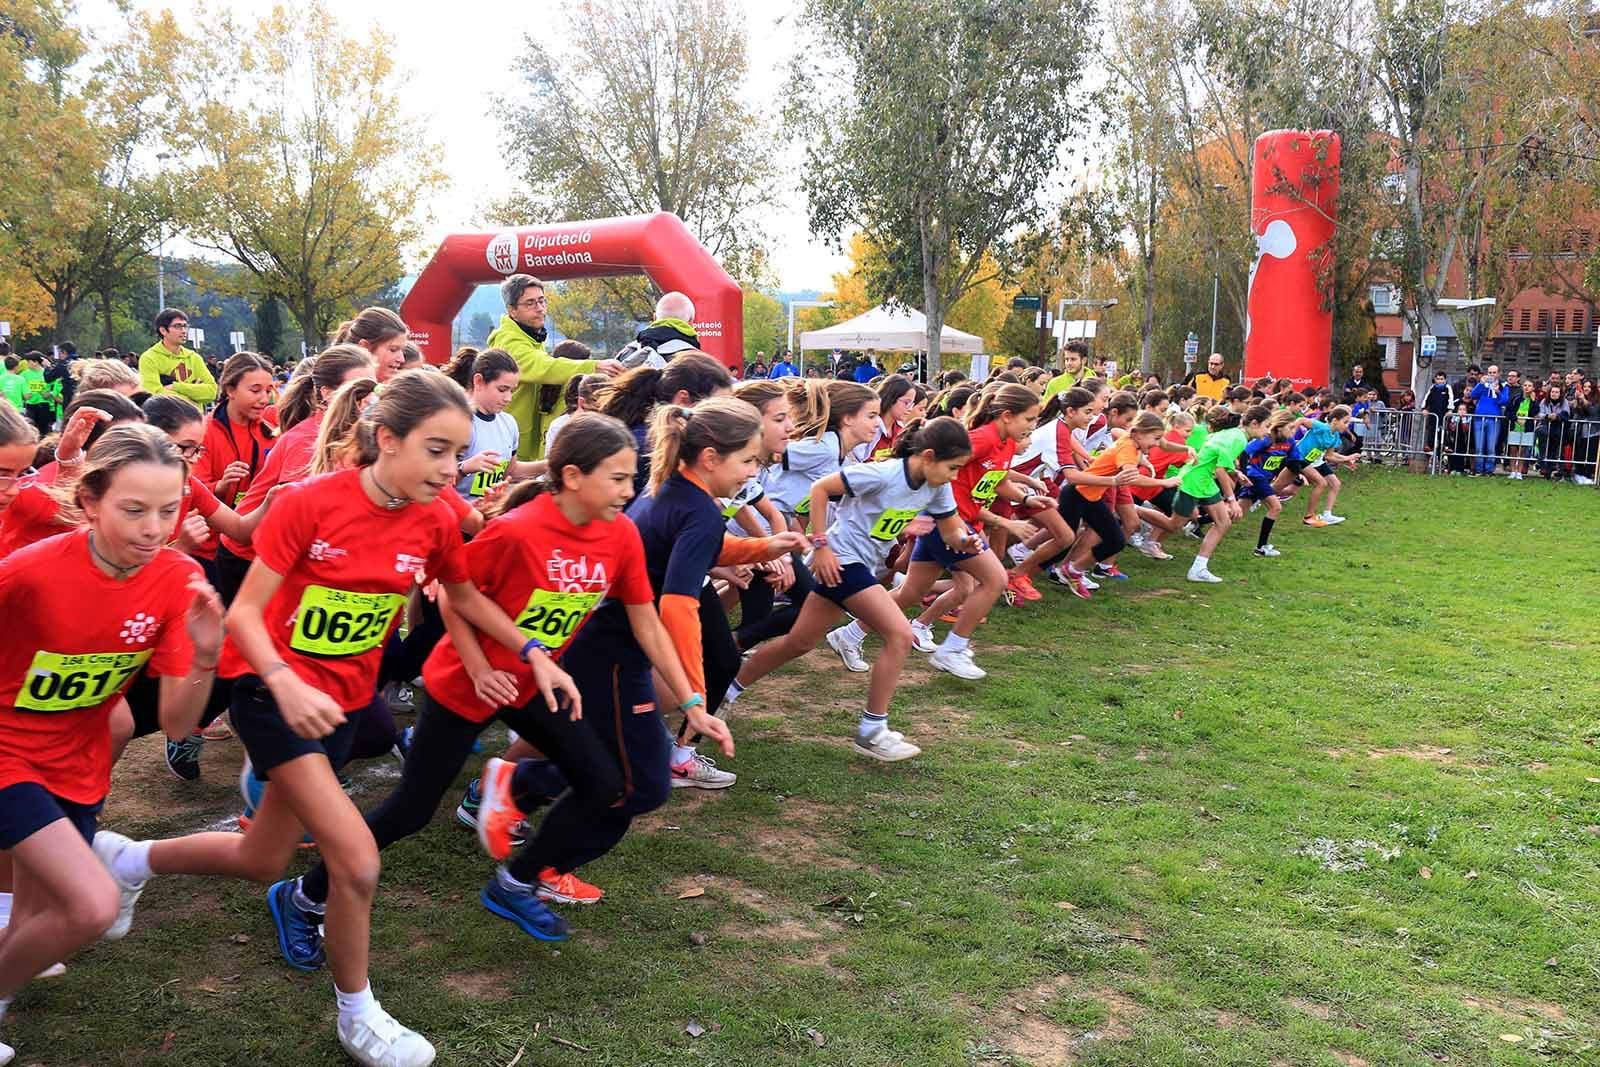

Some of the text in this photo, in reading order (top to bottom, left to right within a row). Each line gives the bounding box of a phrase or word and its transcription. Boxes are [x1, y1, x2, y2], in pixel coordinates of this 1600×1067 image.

[524, 229, 592, 250] Diputació
[524, 251, 592, 267] Barcelona
[302, 606, 392, 644] 0625
[29, 666, 139, 701] 0617
